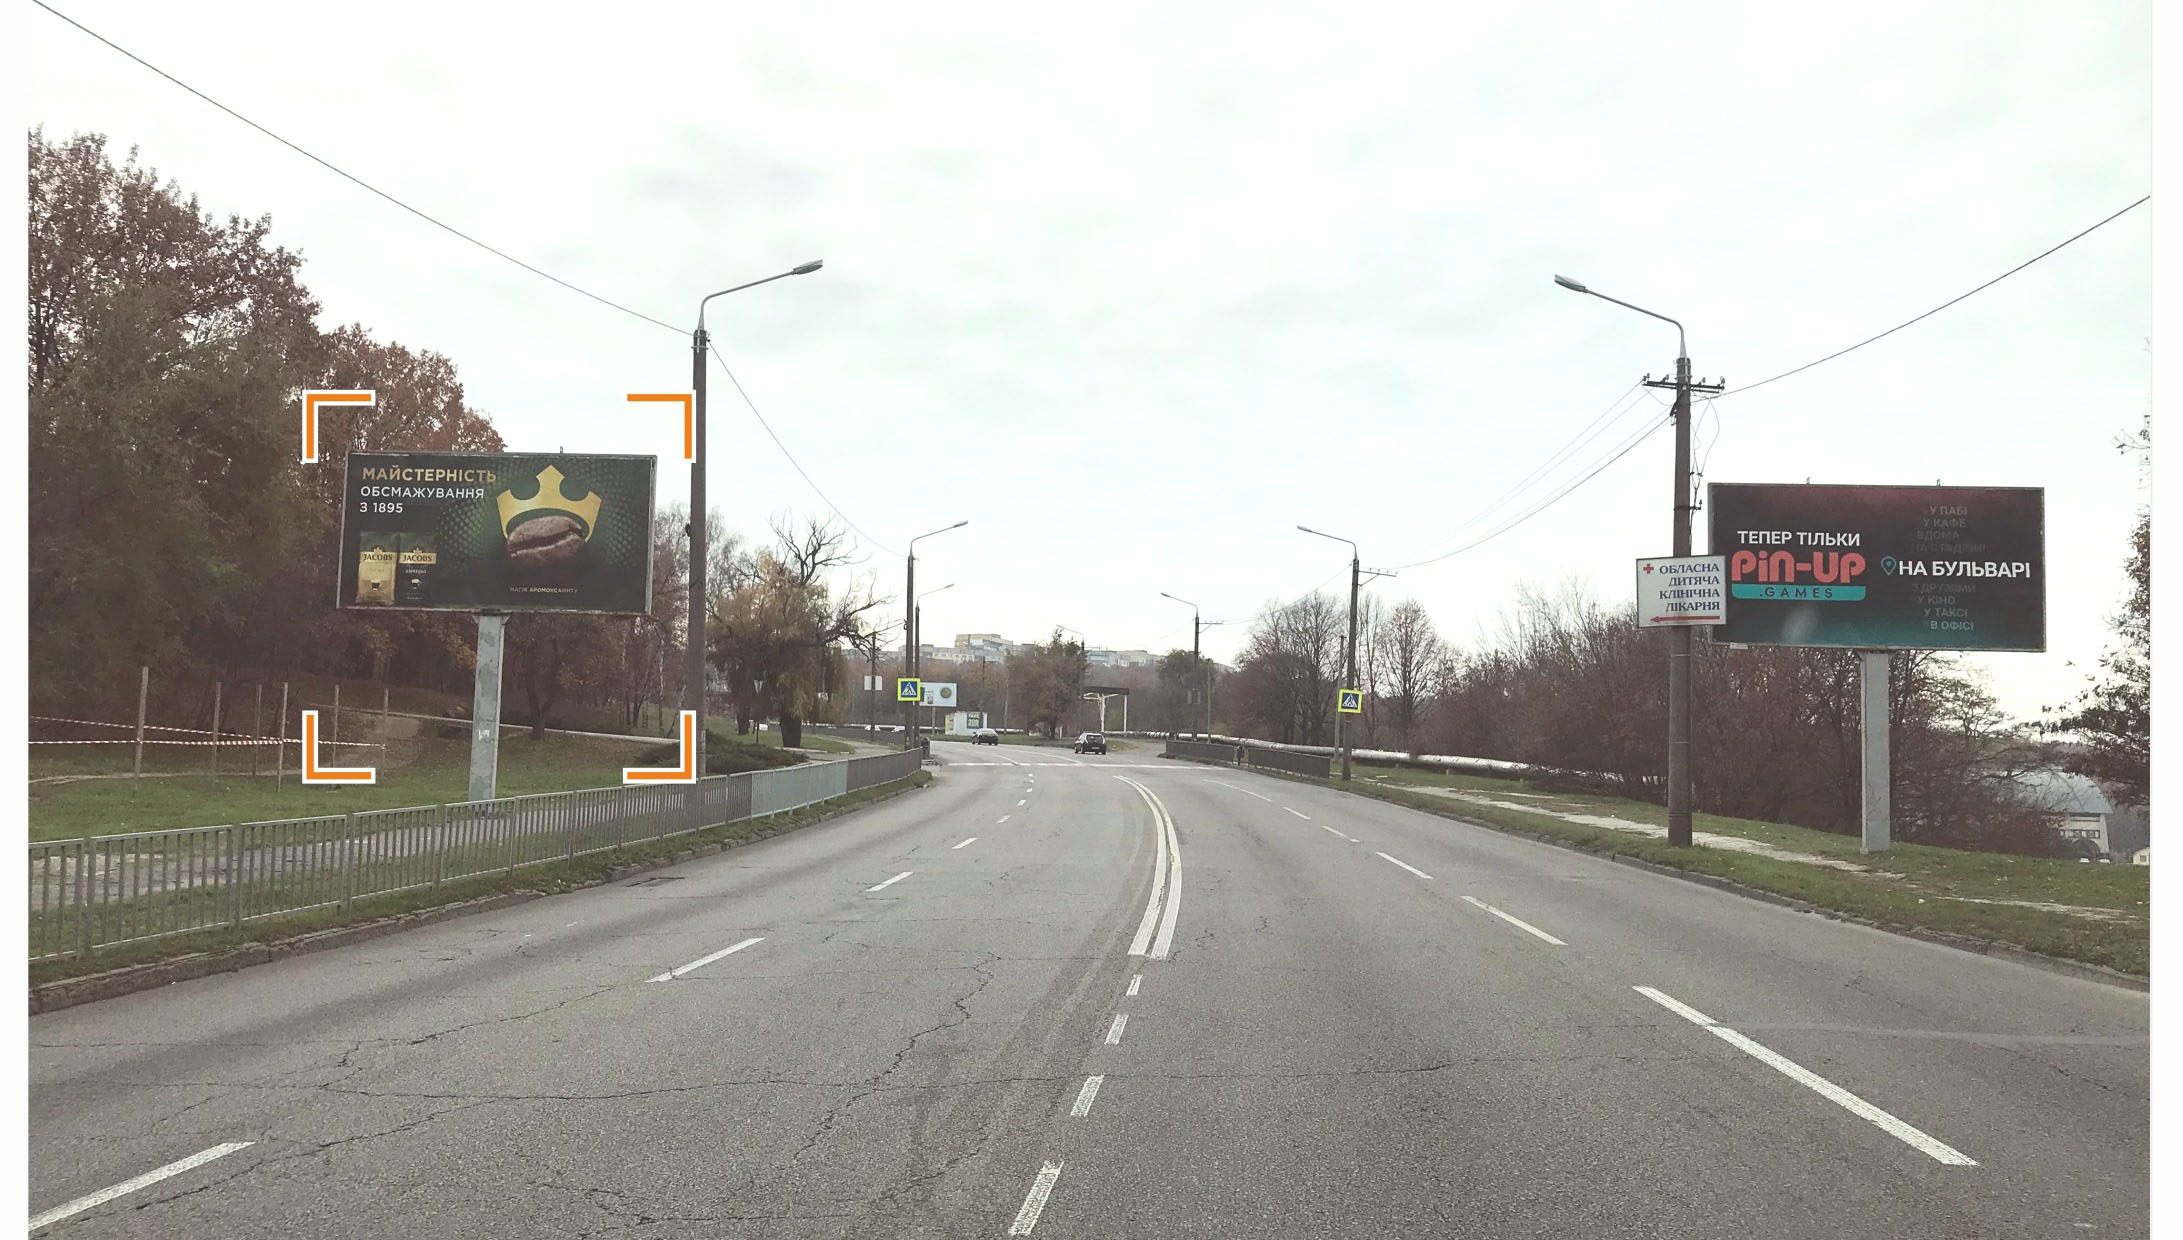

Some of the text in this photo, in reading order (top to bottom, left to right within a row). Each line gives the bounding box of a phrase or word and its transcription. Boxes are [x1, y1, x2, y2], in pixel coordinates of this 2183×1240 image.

[362, 465, 497, 482] МАЙСТЕРНІСТЬ
[360, 486, 485, 499] ОБСМАЖУВАННЯ
[360, 502, 403, 513] З 1895
[1940, 506, 1968, 516] ПАБІ
[1933, 518, 1966, 528] КАФЕ
[1737, 531, 1860, 547] ТЕПЕР ТІЛЬКИ
[363, 553, 393, 561] JACOBS
[403, 554, 433, 562] JACOBS
[1659, 563, 1720, 575] ОБЛАСНА
[1899, 560, 2031, 578] НА БУЛЬВАРІ
[1668, 575, 1720, 587] ДИТЯЧА
[1659, 588, 1720, 600] КЛІНІЧНА
[1760, 586, 1833, 599] .GAMES
[1928, 595, 1956, 605] КІНО
[1665, 601, 1720, 612] ЛІКАРНЯ
[1935, 607, 1968, 618] ТАКСІ
[1930, 620, 1974, 631] В ОФІСІ
